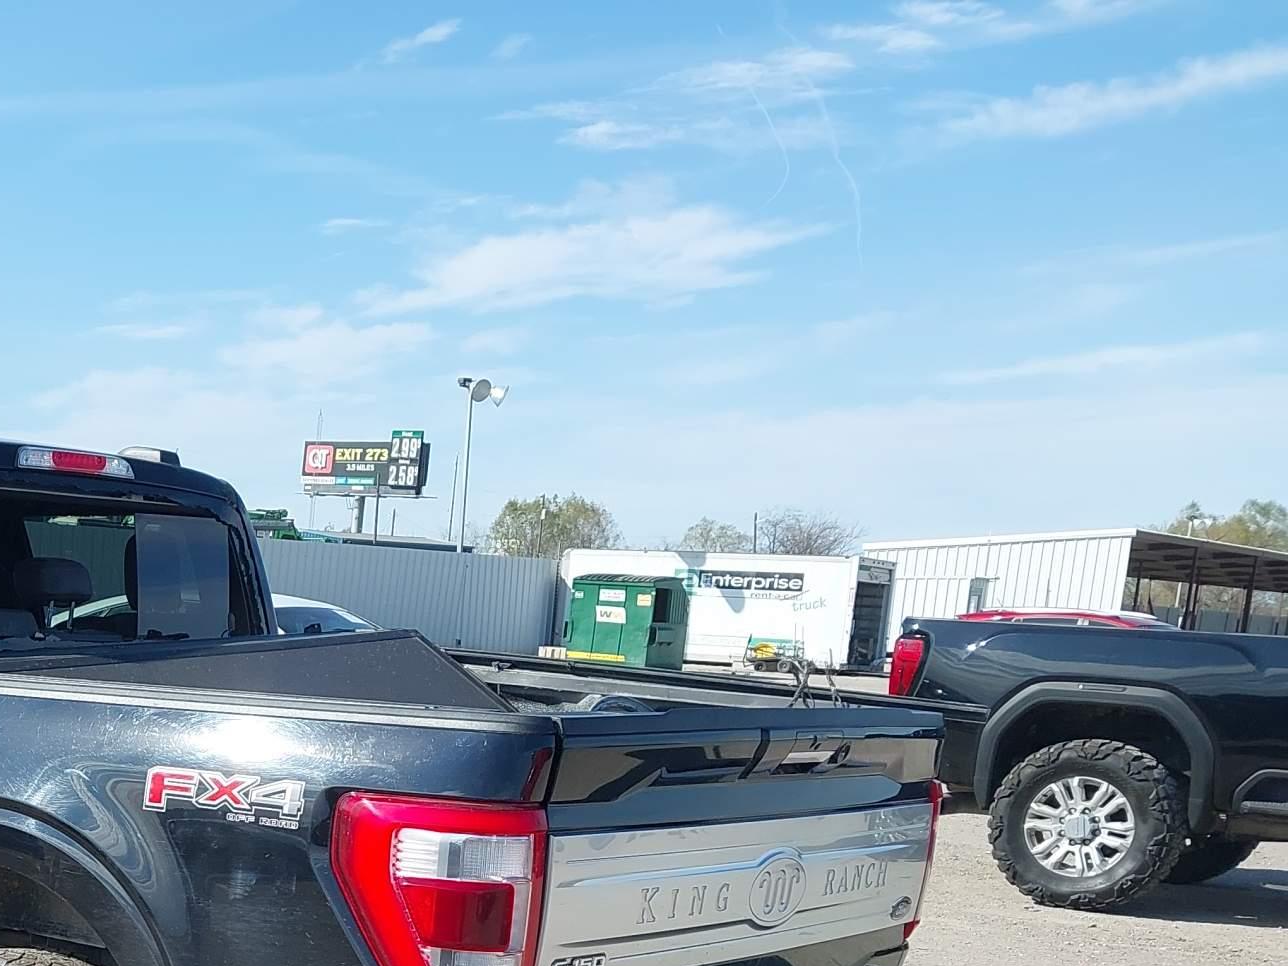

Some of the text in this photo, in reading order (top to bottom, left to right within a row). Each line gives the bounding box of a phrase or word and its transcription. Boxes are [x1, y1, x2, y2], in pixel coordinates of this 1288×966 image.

[309, 448, 329, 470] QT
[335, 448, 389, 461] EXIT 273
[700, 573, 803, 591] Enterprise
[792, 596, 827, 612] truck
[143, 766, 305, 821] FX4
[226, 812, 299, 830] OFF ROAD
[636, 861, 889, 925] KING RANCH
